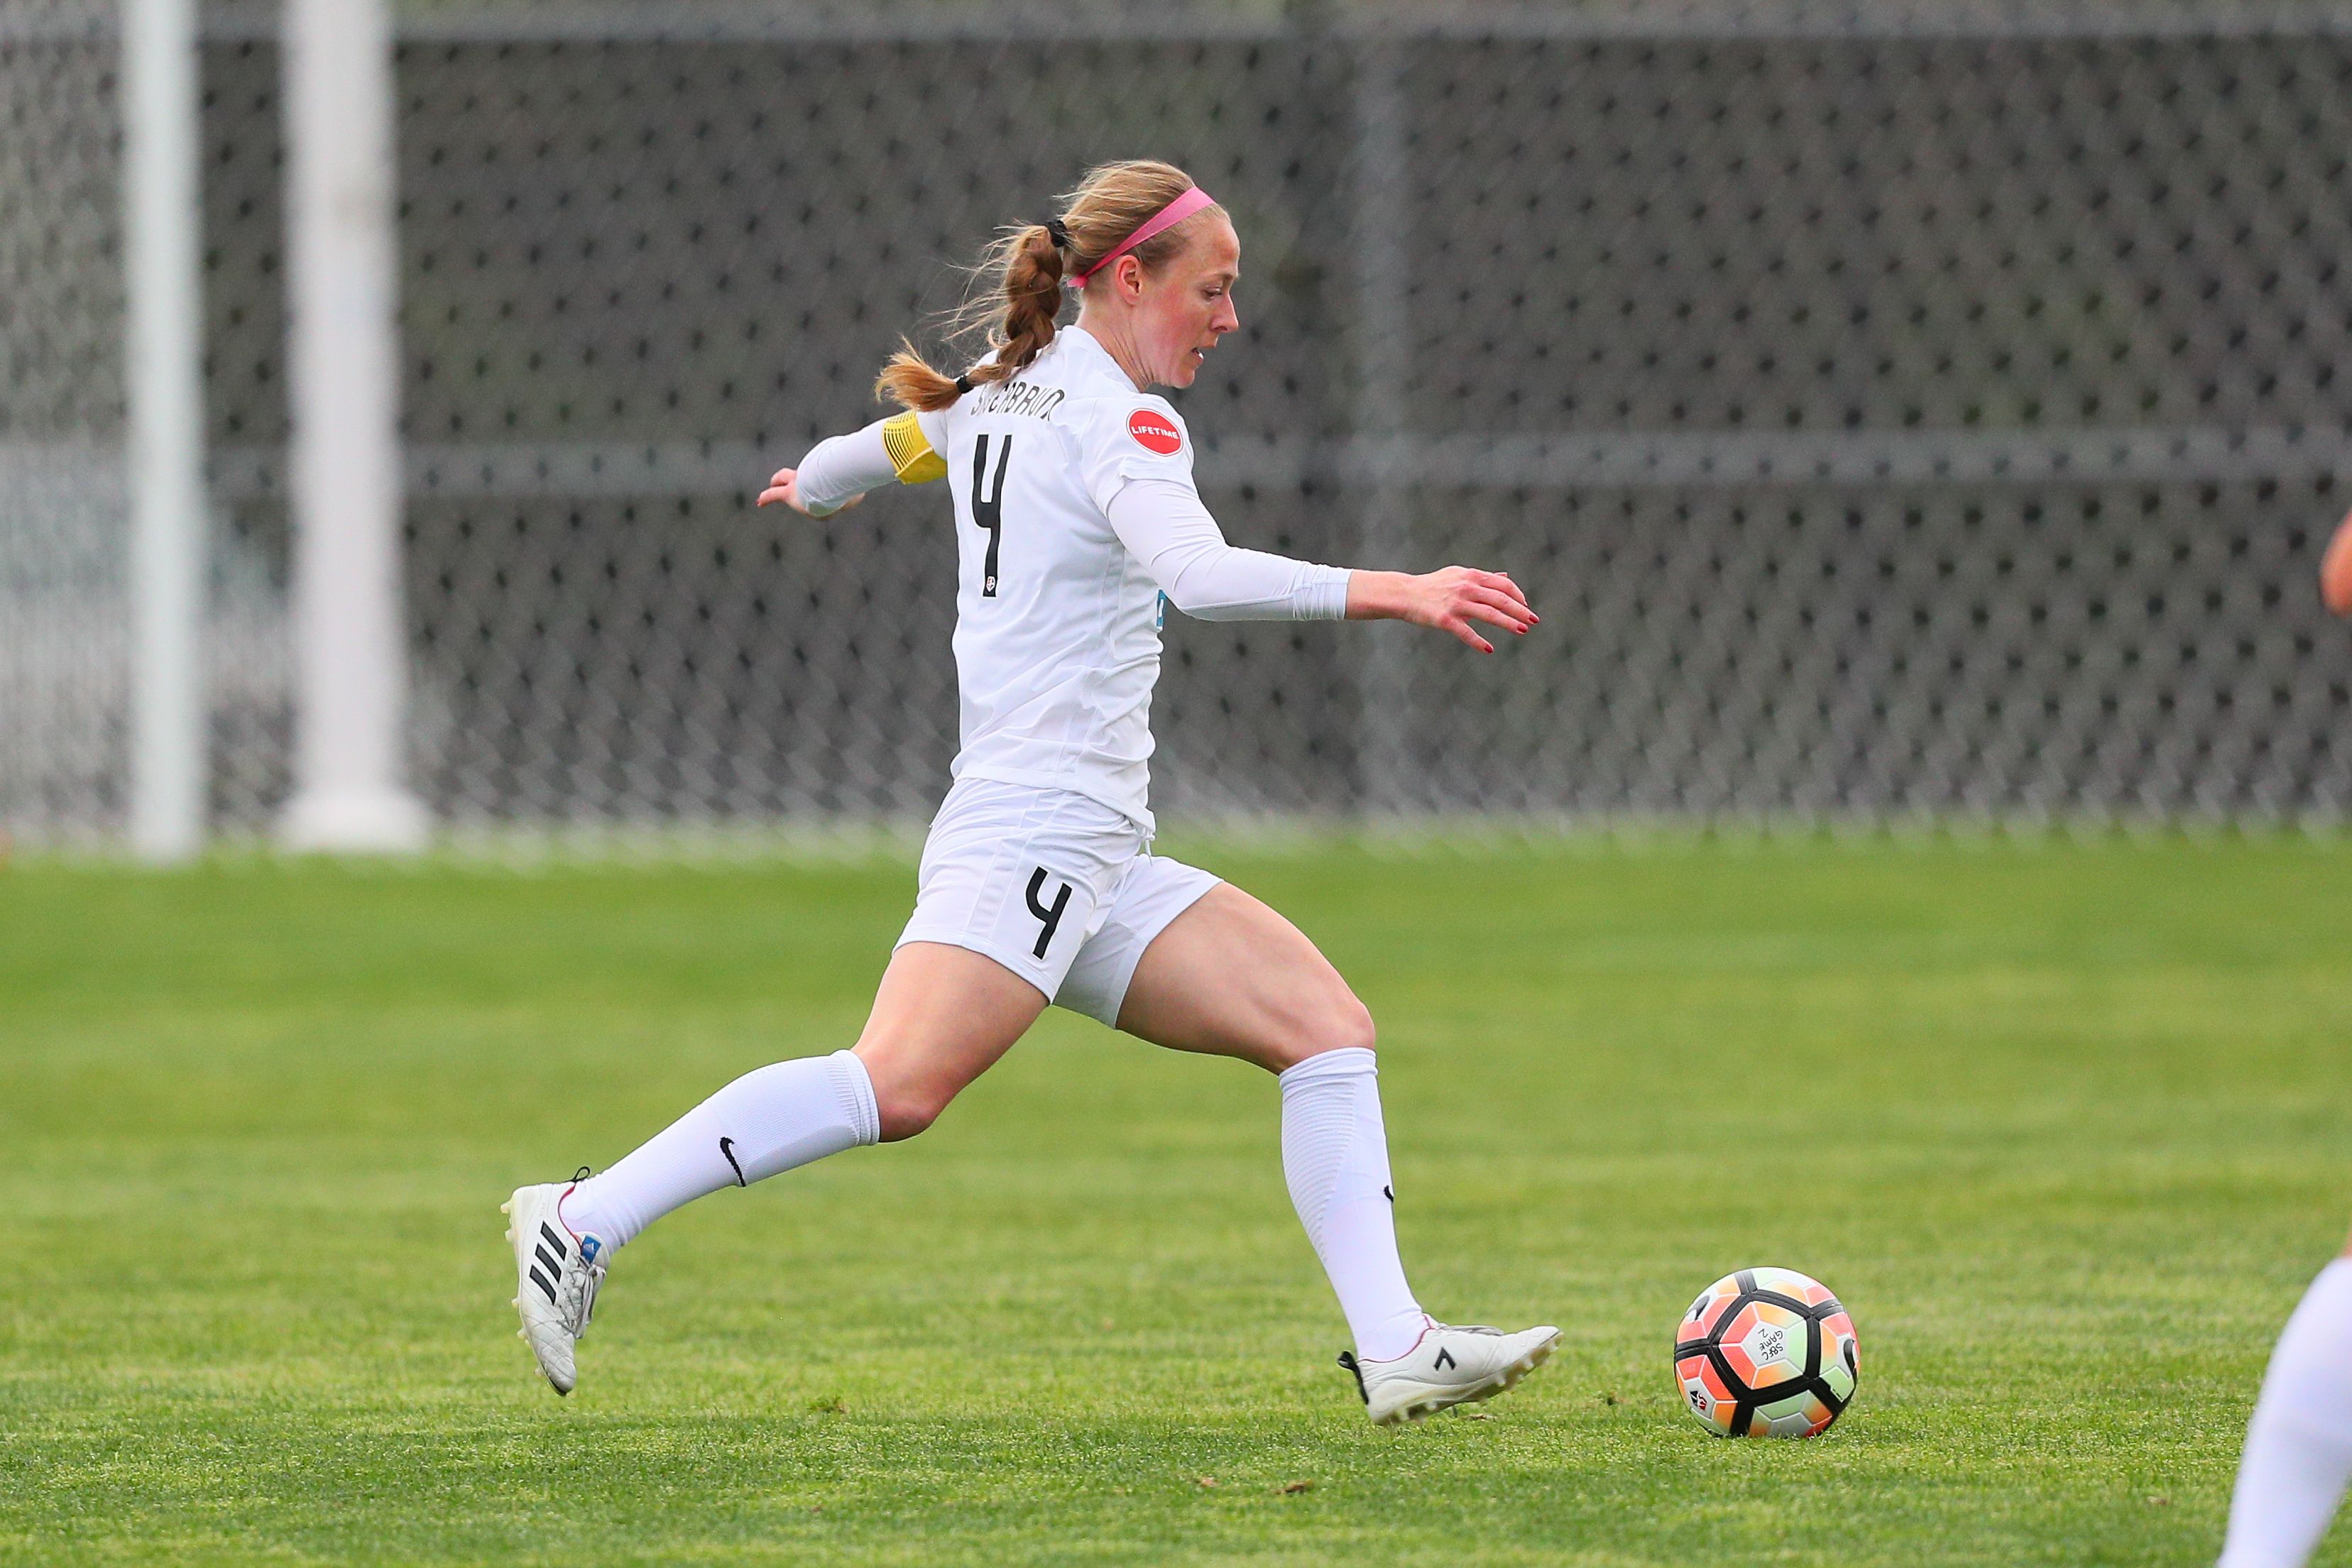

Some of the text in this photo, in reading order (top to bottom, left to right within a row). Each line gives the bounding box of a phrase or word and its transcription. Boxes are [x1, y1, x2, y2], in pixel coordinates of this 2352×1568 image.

[1131, 426, 1179, 439] LIFETIME
[971, 434, 1012, 597] 4
[1025, 865, 1073, 960] 4
[1758, 1330, 1783, 1351] GAME
